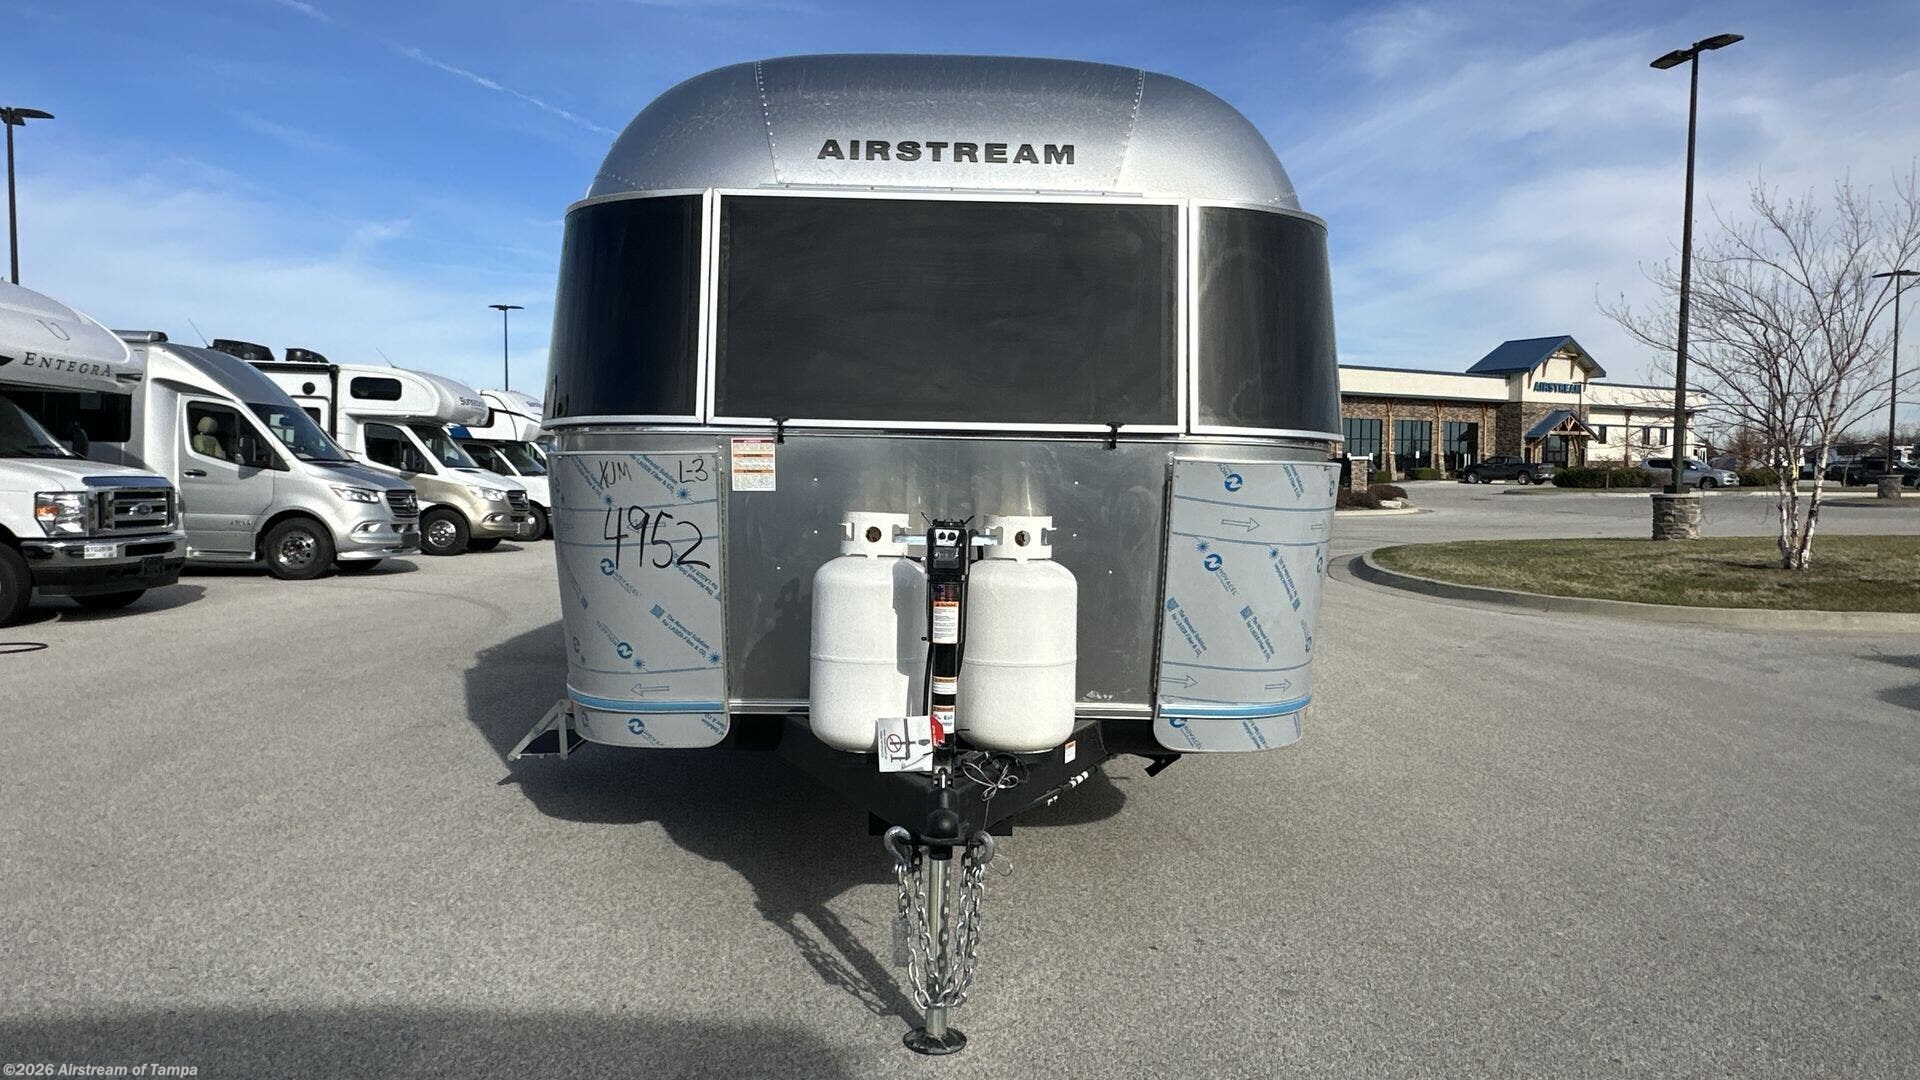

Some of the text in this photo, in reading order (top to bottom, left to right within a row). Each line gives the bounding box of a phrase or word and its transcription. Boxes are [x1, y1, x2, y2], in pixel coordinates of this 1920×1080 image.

[817, 139, 1075, 165] AIRSTREAM
[22, 352, 113, 378] ENTEGRA
[1533, 381, 1581, 394] AIRSTREAM
[604, 505, 710, 570] 4952
[1216, 567, 1239, 596] NOVACEL
[666, 613, 675, 622] The
[691, 633, 710, 650] Solution
[667, 623, 684, 638] LASER
[1175, 618, 1188, 634] LASER
